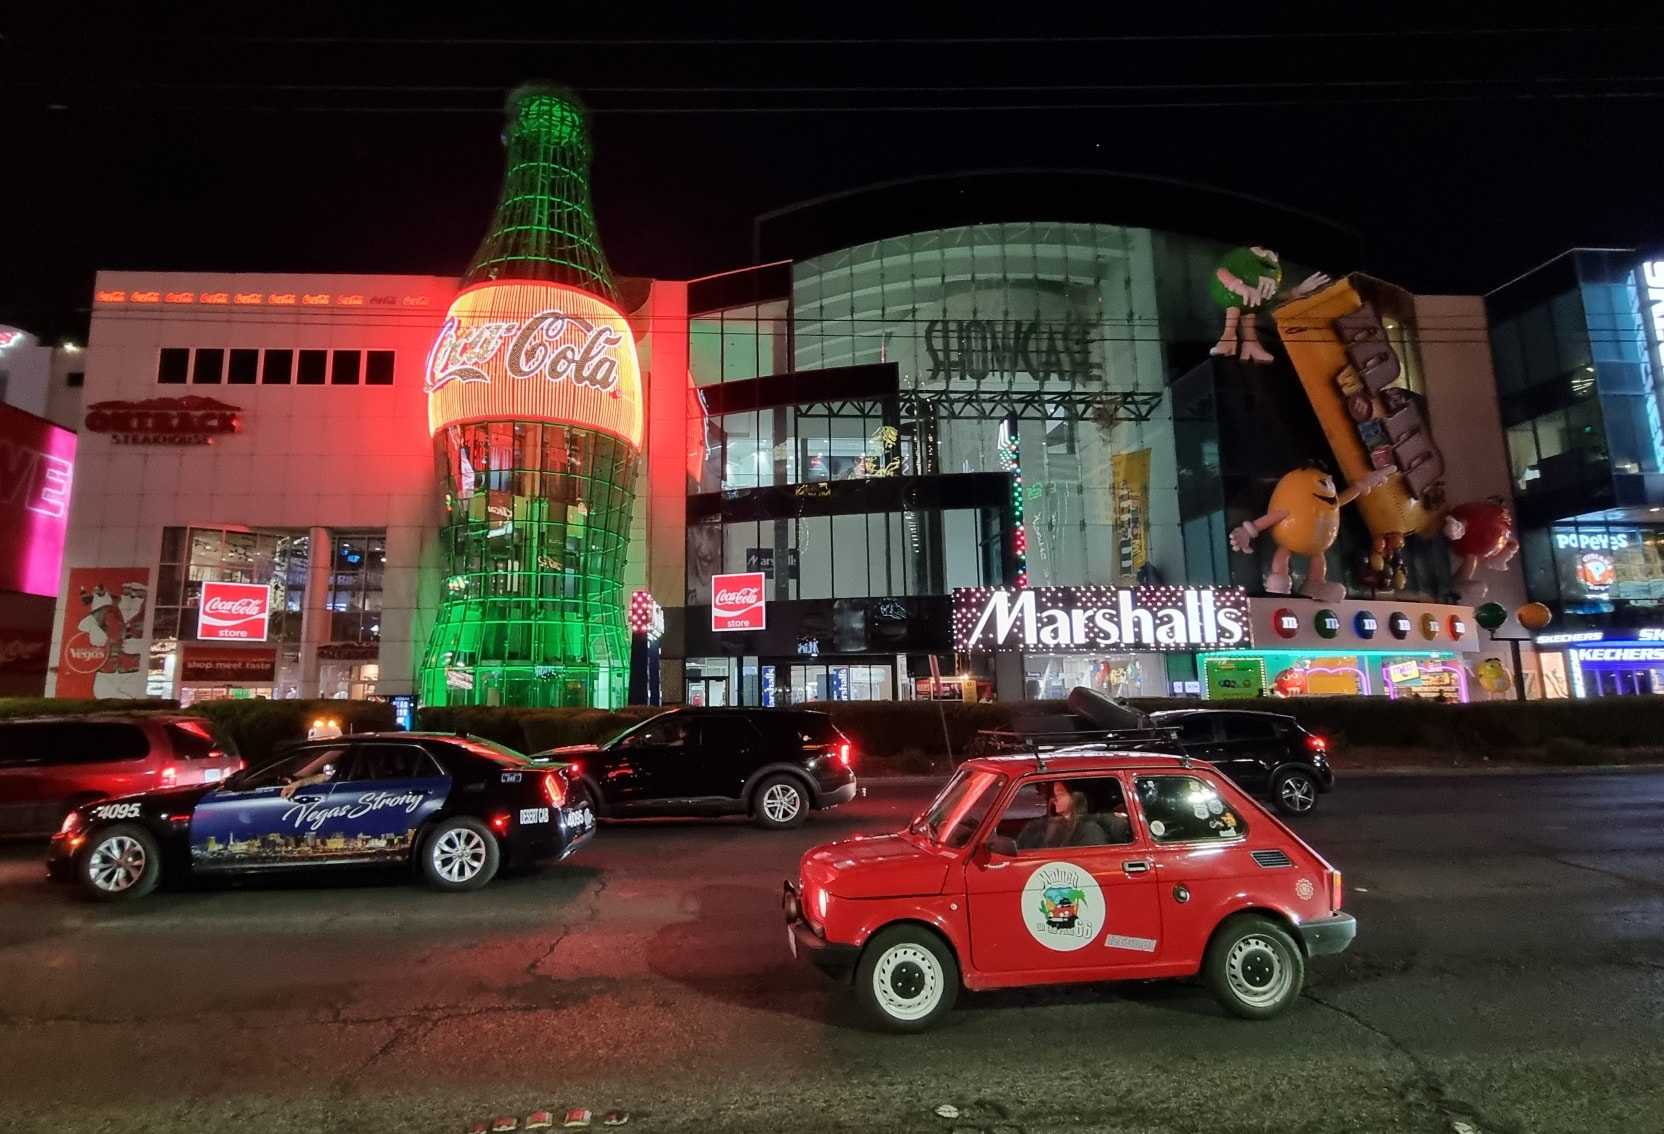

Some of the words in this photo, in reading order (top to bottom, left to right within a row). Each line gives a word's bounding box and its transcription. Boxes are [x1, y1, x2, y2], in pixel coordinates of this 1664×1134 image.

[728, 620, 750, 628] store
[969, 590, 1243, 647] Marshalls
[1580, 648, 1664, 661] KECHERS
[97, 803, 141, 819] 4095
[282, 803, 349, 830] Vegas
[347, 792, 424, 818] Strong
